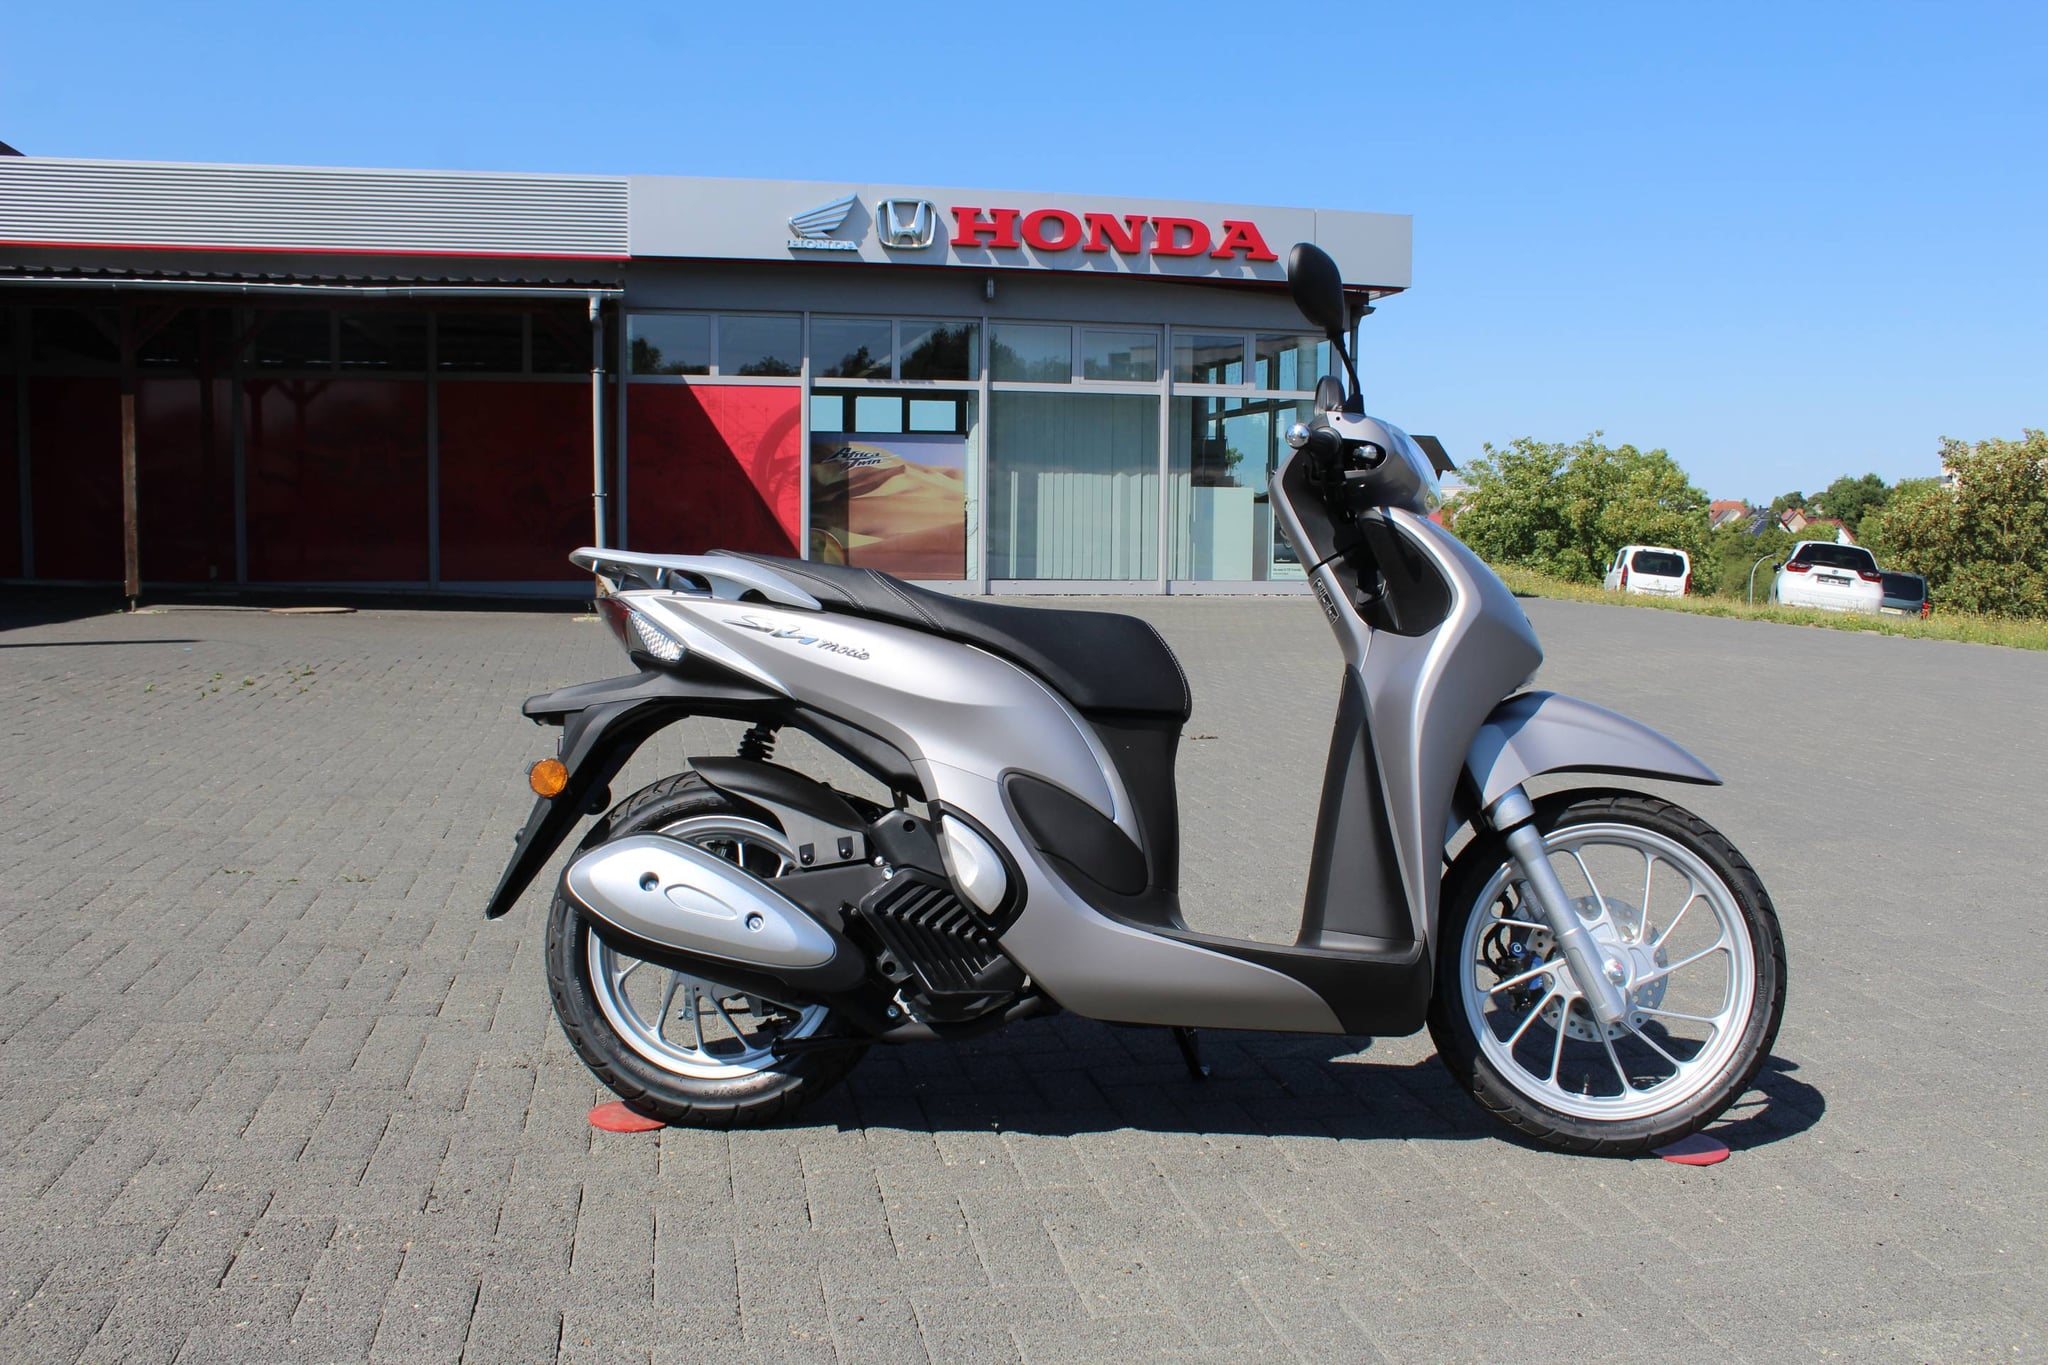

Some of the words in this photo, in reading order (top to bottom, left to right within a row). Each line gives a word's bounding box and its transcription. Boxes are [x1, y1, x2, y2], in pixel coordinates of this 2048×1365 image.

[951, 206, 1279, 261] HONDA
[788, 239, 859, 251] HONDA
[829, 447, 880, 460] Africa
[841, 459, 881, 472] Twin
